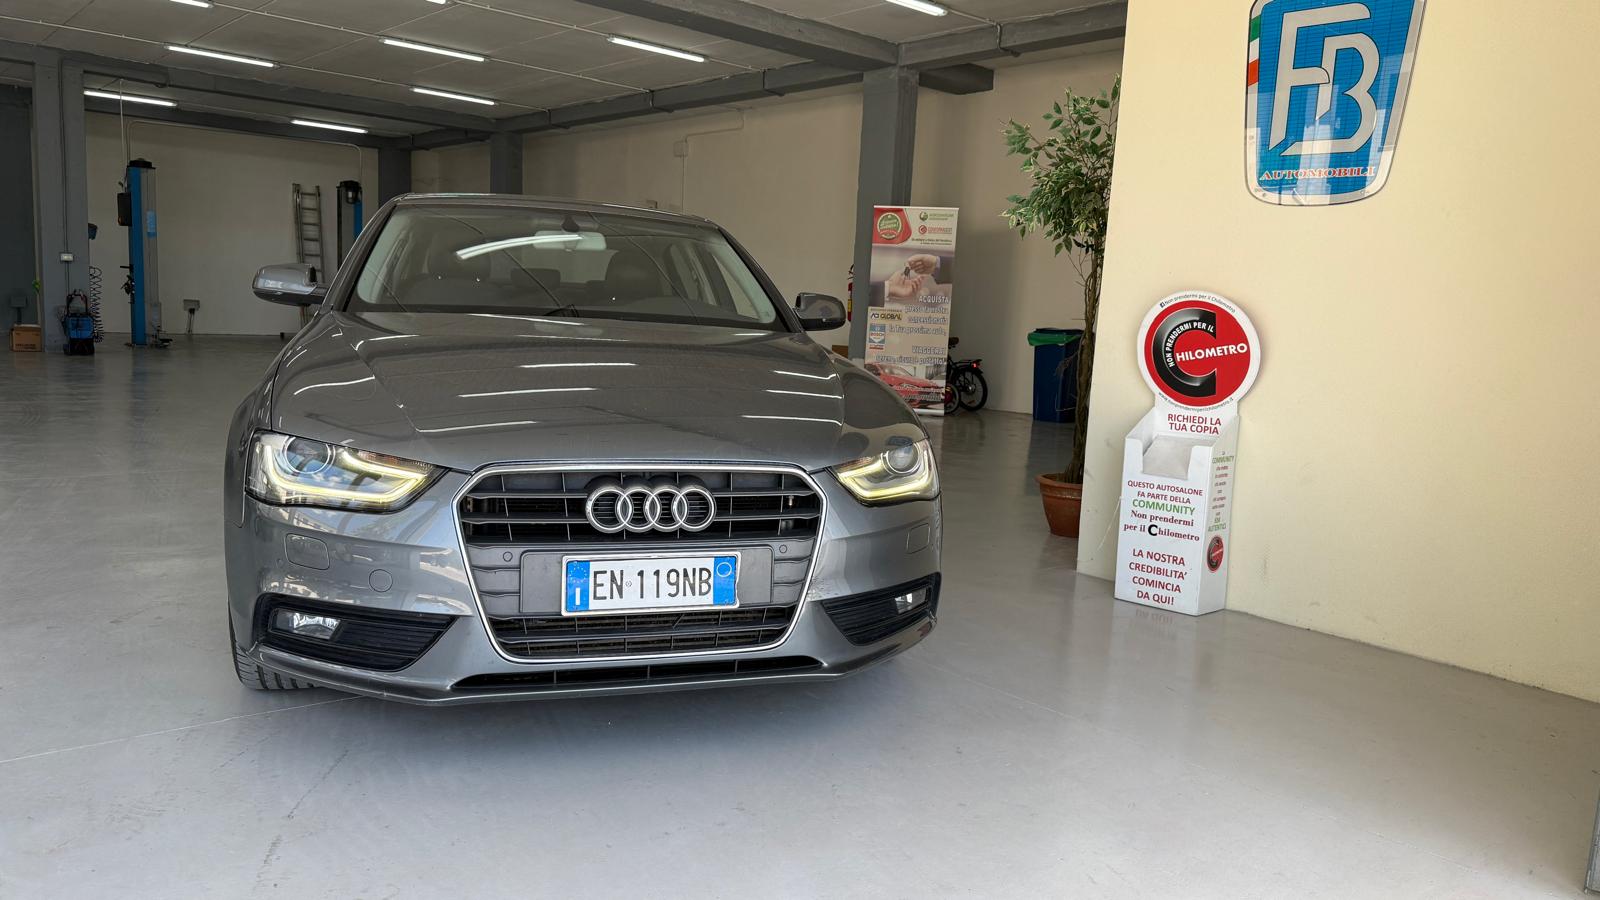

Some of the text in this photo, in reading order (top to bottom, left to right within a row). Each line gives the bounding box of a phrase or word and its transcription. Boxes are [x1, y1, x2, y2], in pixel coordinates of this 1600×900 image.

[1259, 166, 1376, 181] AUTOMOBILI
[919, 295, 949, 304] ACQUISTA
[1211, 296, 1236, 313] Chilometro
[880, 313, 902, 321] GLOBAL
[1165, 321, 1215, 367] NON PRENDERMI PER IL
[1167, 413, 1221, 426] RICHIEDI LA
[1169, 422, 1219, 435] TUA COPIA
[1127, 480, 1155, 490] QUESTO
[1156, 484, 1203, 496] AUTOSALONE
[1147, 492, 1168, 501] PARTE
[1169, 495, 1191, 504] DELLA
[1132, 498, 1195, 516] COMMUNITY
[1131, 510, 1194, 527] Non prendermi
[1123, 523, 1137, 532] per
[1147, 524, 1200, 542] Chilometro
[1132, 548, 1185, 567] LA NOSTRA
[593, 567, 712, 600] EN 119NB
[1132, 576, 1181, 593] COMINCIA
[1137, 590, 1175, 606] DA QUI!
